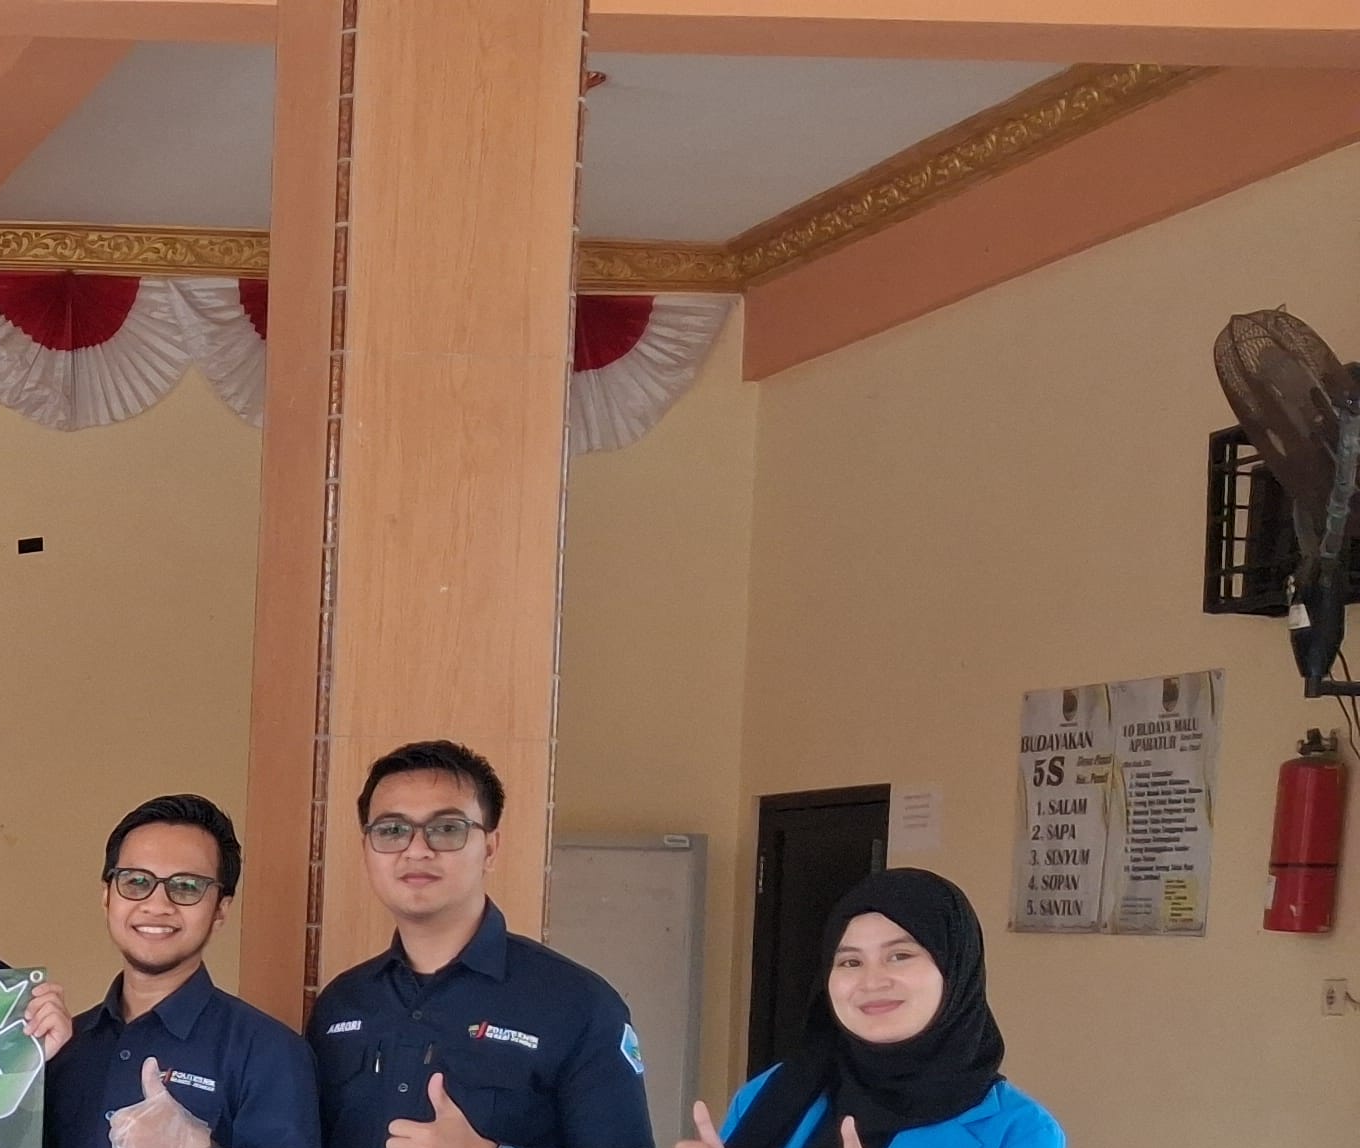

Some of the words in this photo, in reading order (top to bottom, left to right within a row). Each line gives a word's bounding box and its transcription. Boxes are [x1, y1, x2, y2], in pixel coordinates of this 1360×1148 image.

[1020, 731, 1094, 753] BUDAYAKAN
[1033, 756, 1065, 787] 5S
[1048, 798, 1087, 815] SALAM
[1047, 824, 1076, 840] SAPA
[1045, 849, 1090, 865] SENYUM
[1041, 874, 1080, 891] SOPAN
